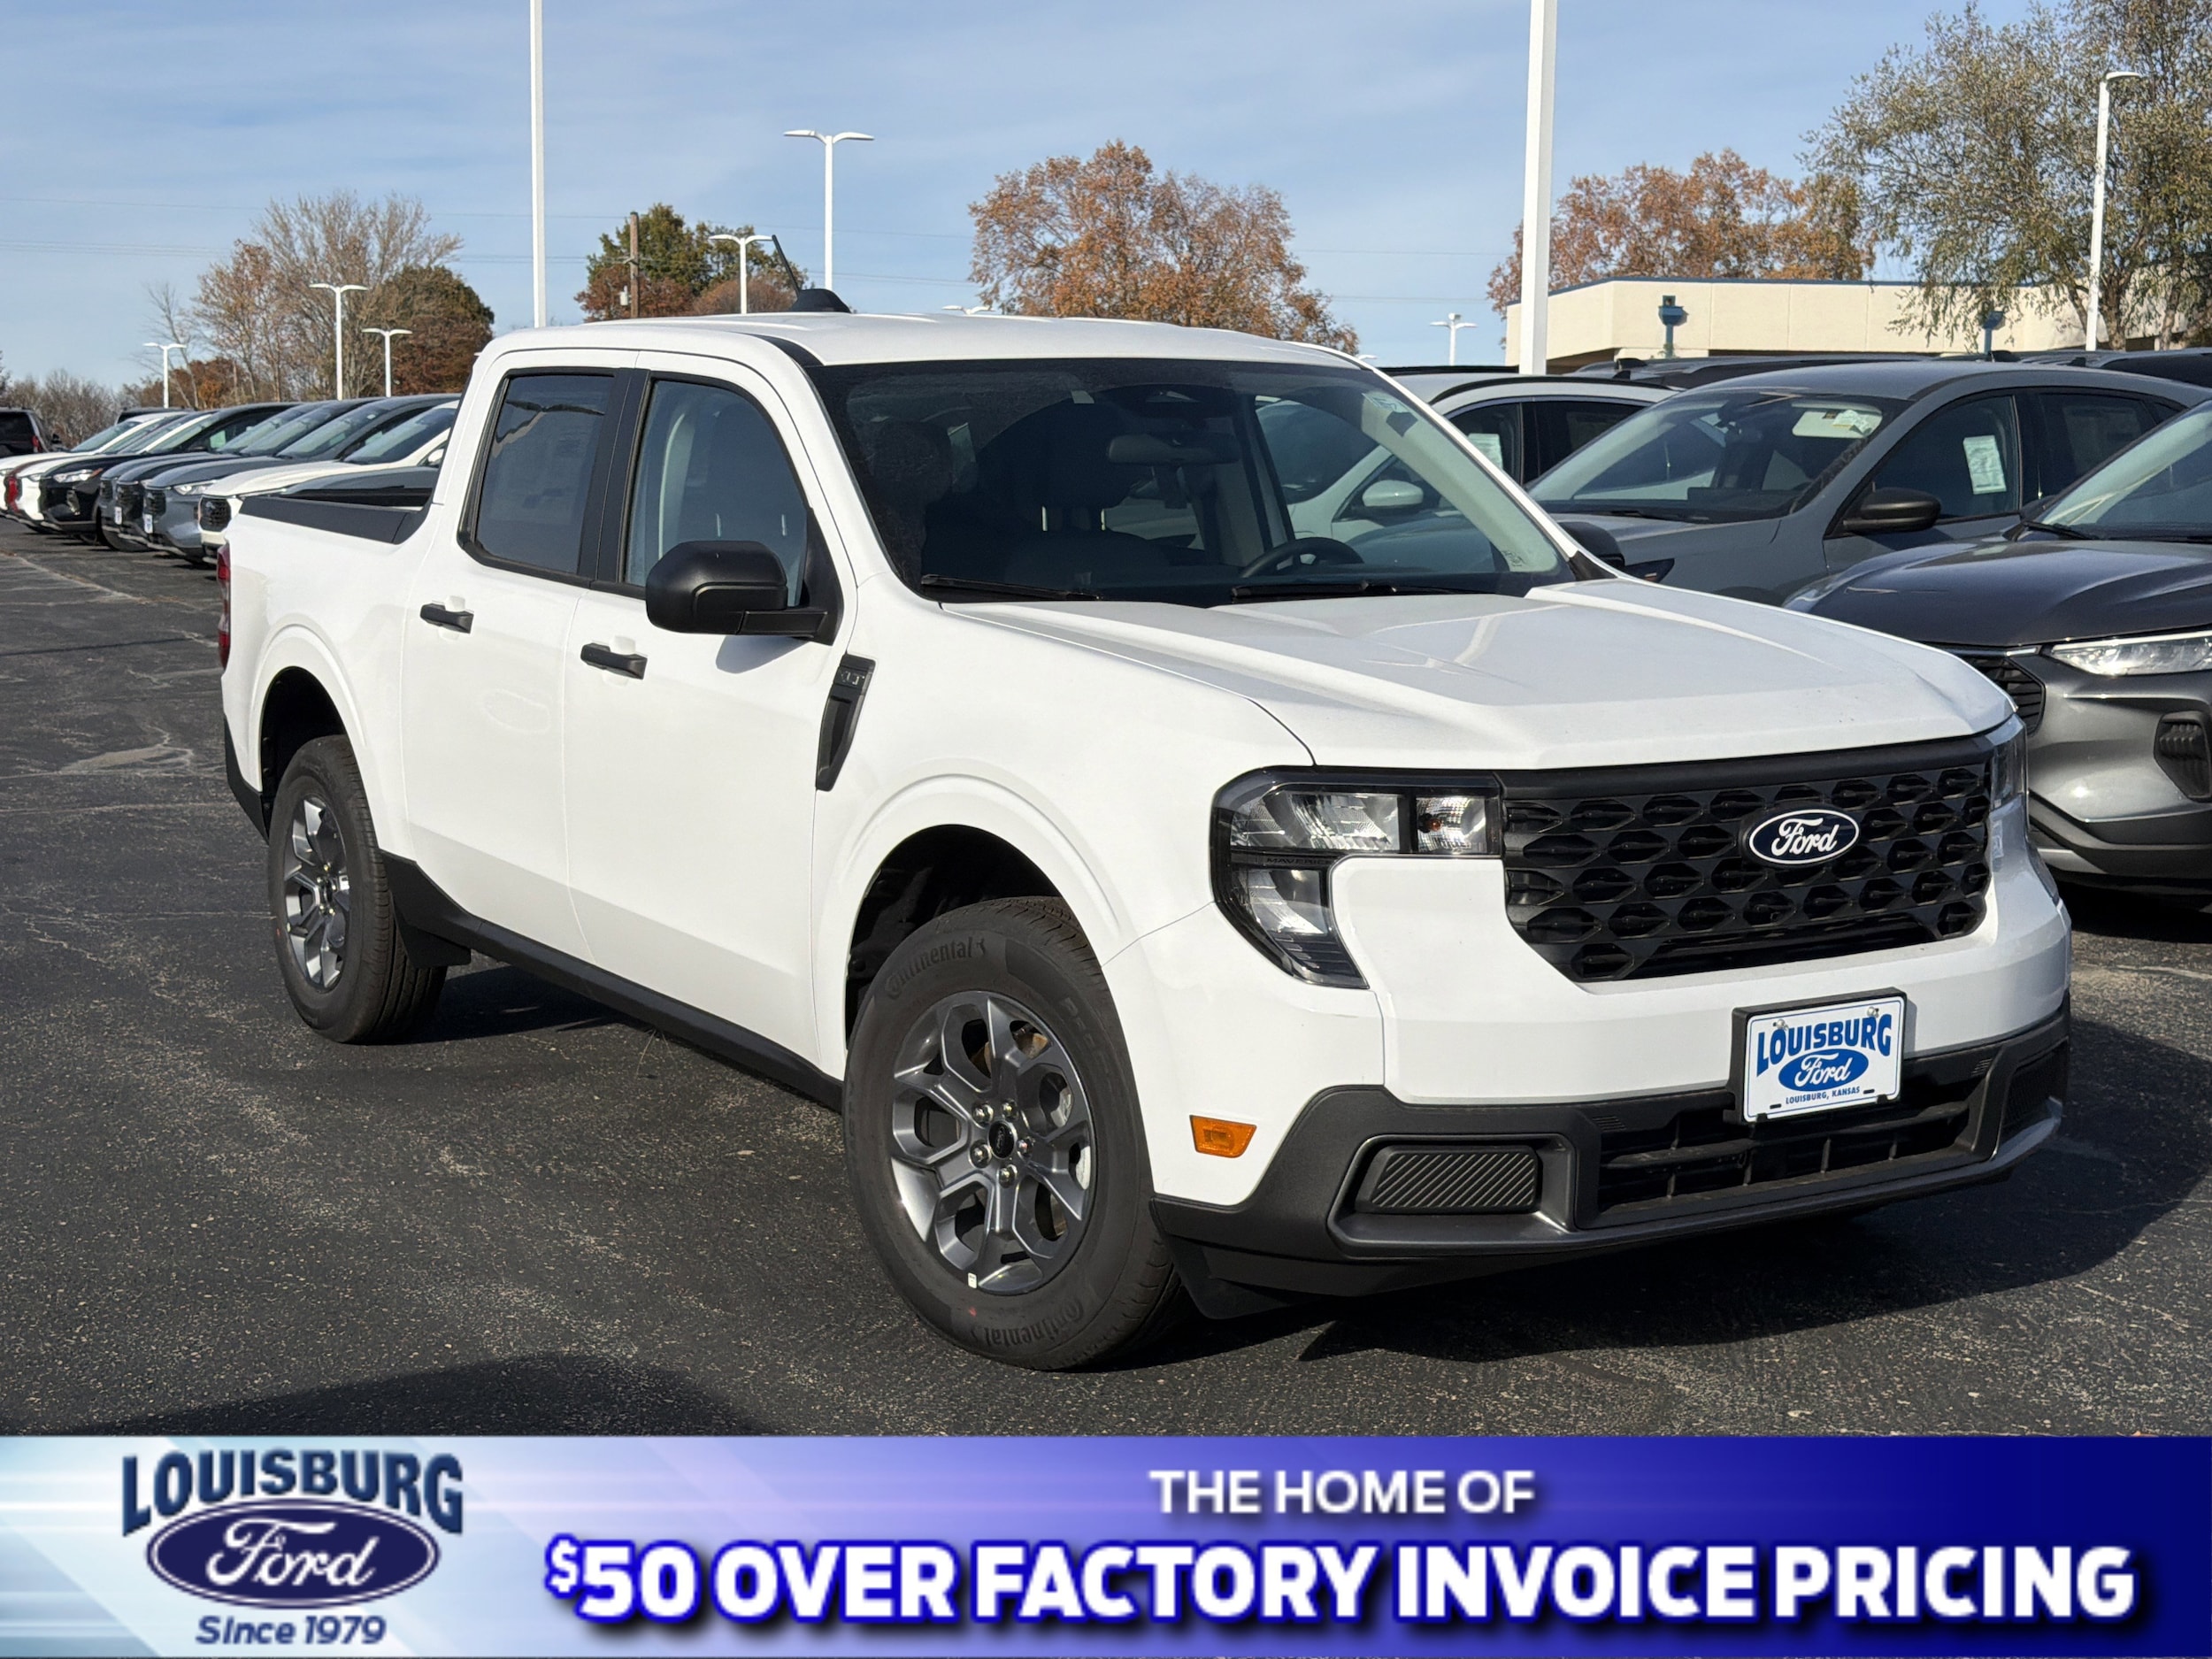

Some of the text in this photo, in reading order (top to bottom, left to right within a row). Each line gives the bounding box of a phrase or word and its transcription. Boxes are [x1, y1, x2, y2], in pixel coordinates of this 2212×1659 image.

[1770, 818, 1840, 856] Ford
[1756, 1013, 1893, 1078] LOUISBURG
[1794, 1052, 1854, 1088] Ford
[1786, 1086, 1861, 1105] LOUISBURG, KANSAS
